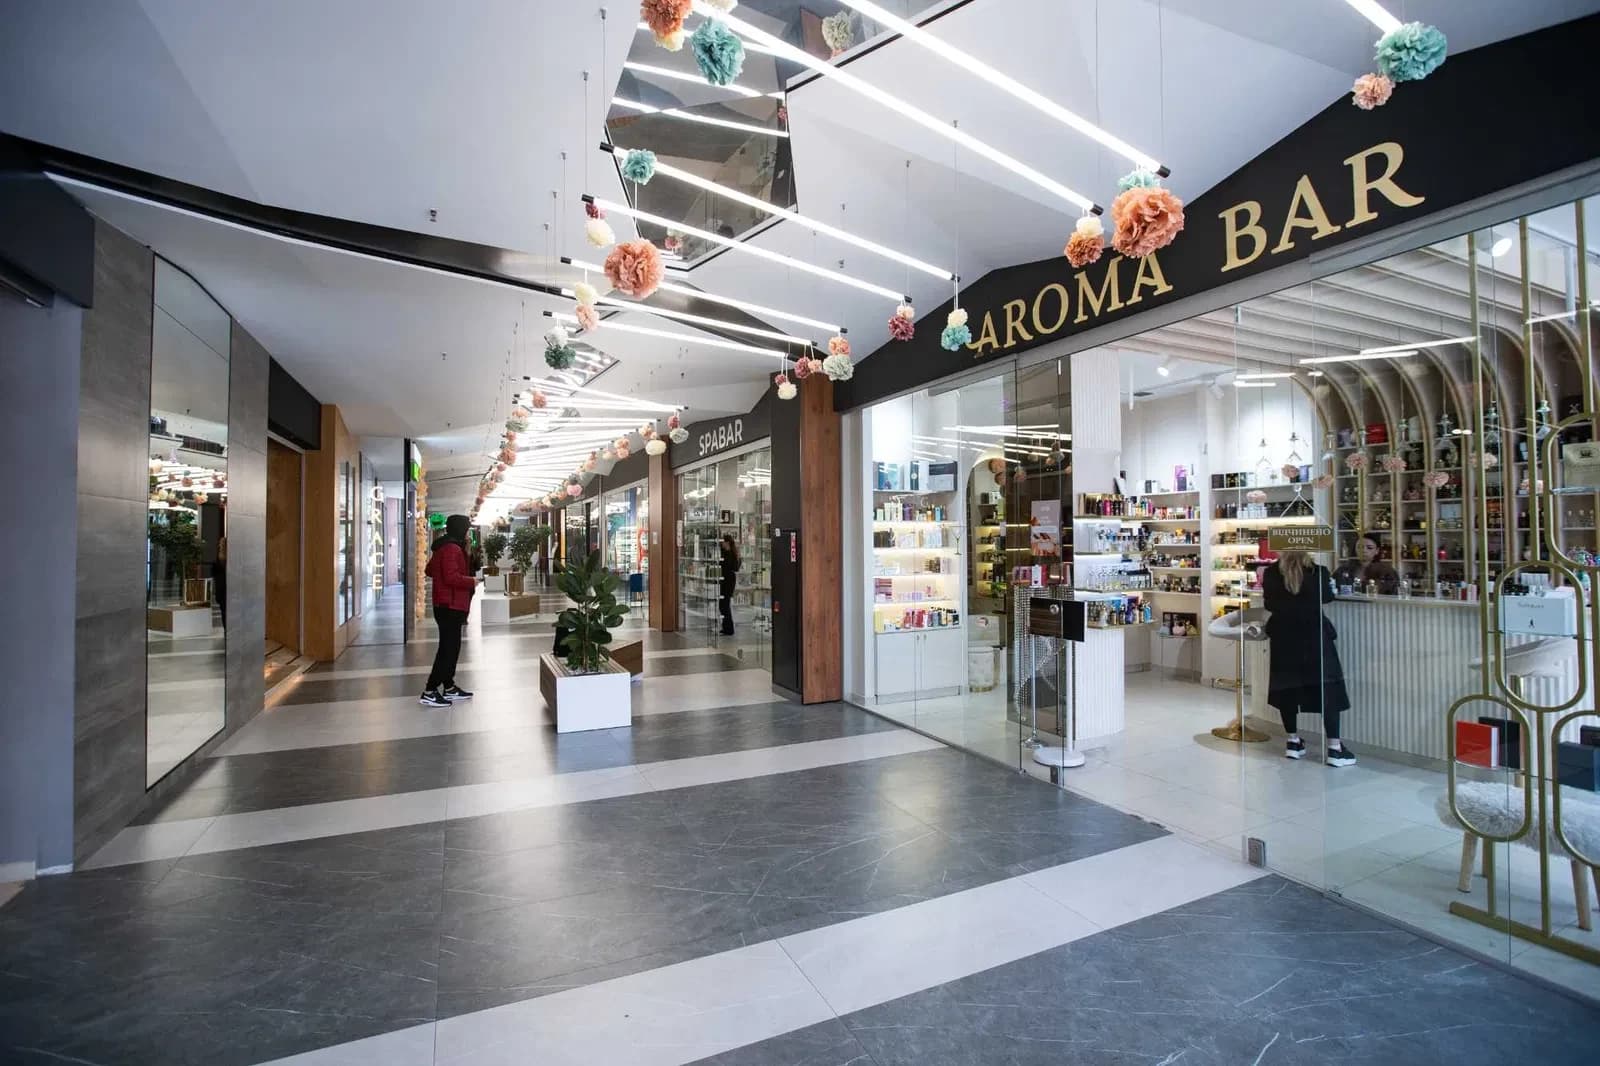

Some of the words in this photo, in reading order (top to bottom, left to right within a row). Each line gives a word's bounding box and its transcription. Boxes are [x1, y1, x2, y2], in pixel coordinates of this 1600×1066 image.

[966, 250, 1173, 357] AROMA
[1218, 141, 1425, 273] BAR
[699, 418, 743, 456] SPABAR
[371, 486, 384, 590] GRACE
